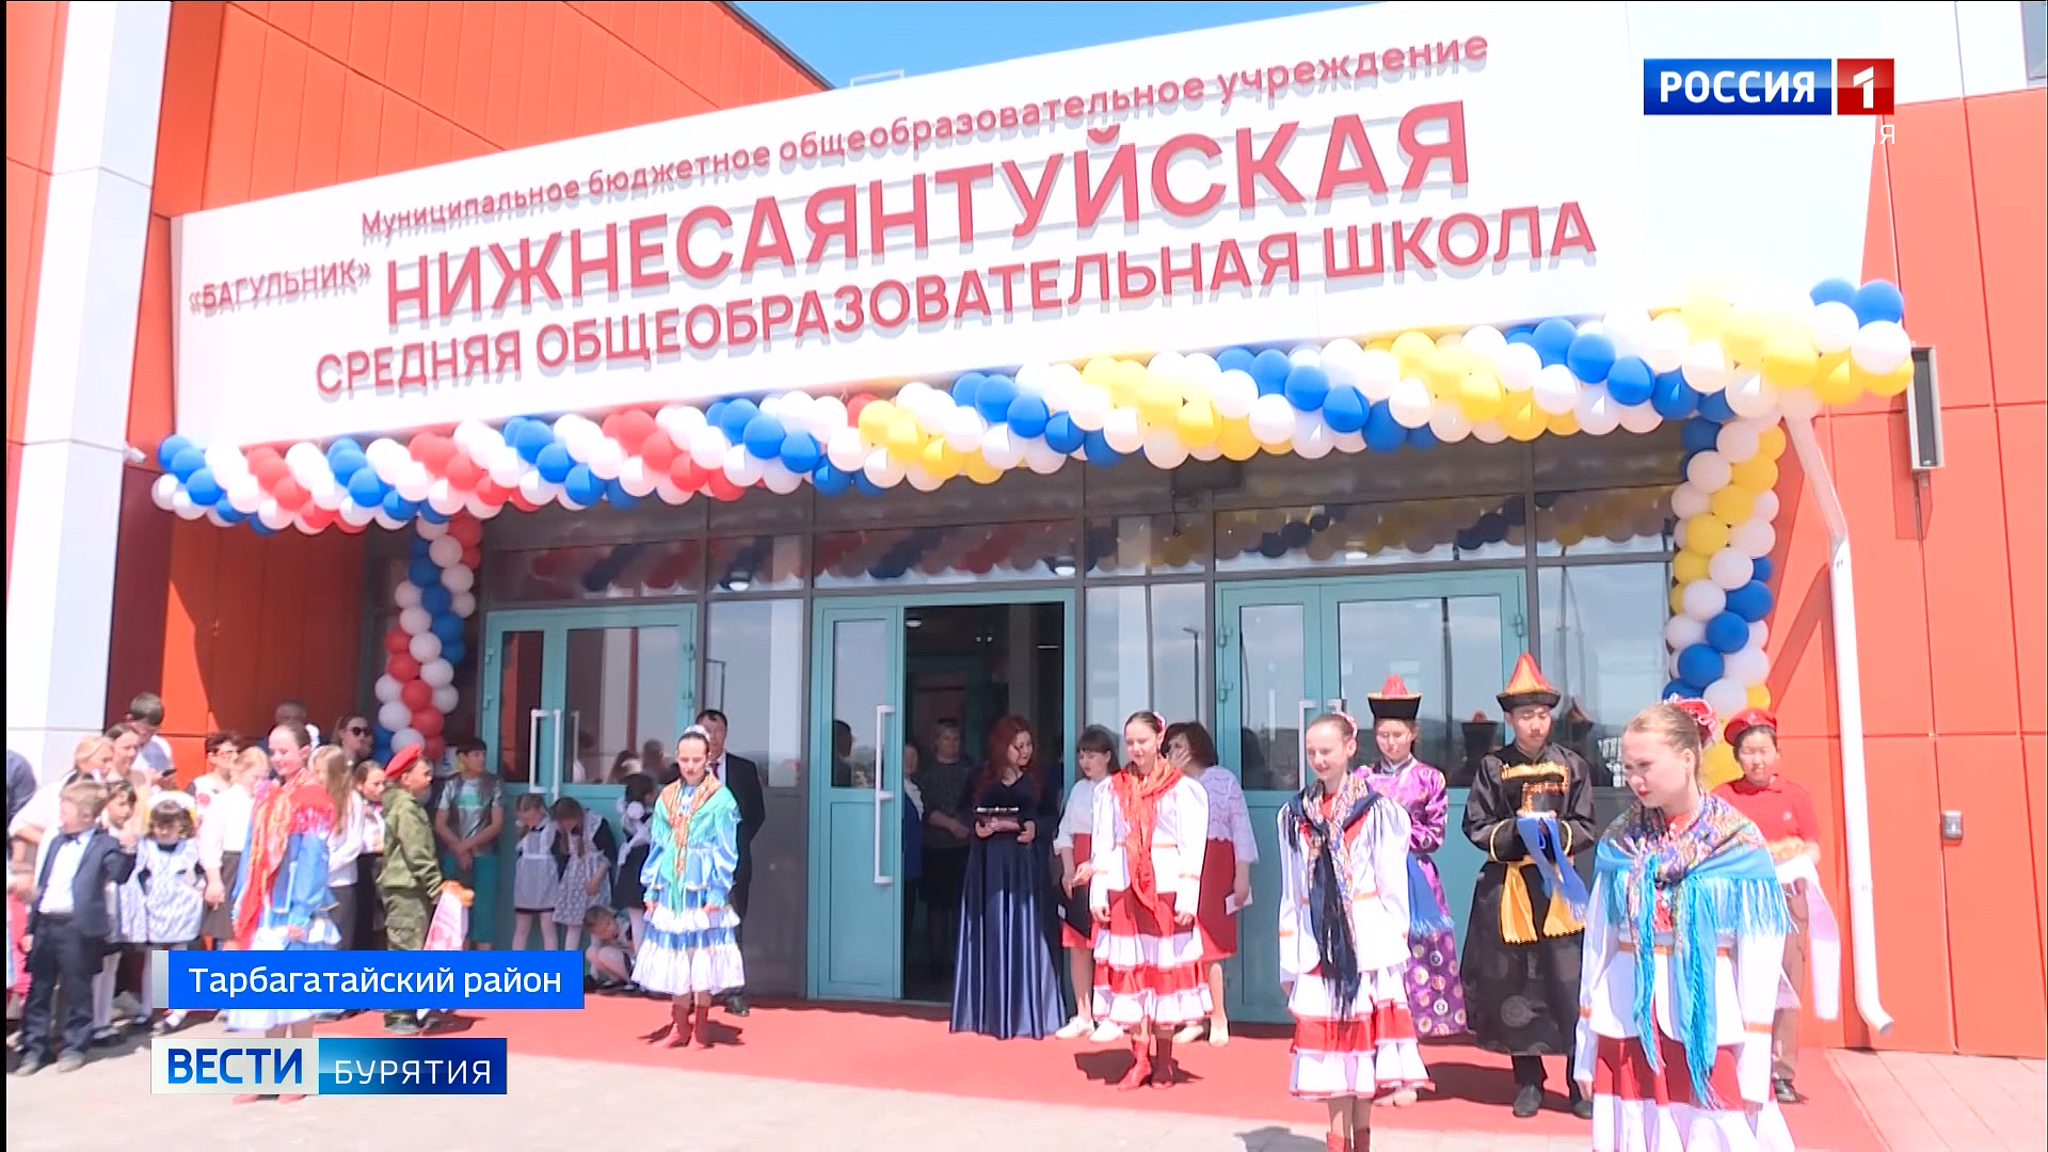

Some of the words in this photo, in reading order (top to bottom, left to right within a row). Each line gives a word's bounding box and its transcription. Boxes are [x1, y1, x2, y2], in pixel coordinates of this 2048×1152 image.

[361, 177, 580, 238] Муниципальное
[588, 143, 771, 193] бюджетное
[780, 76, 1205, 162] общеобразовательное
[1217, 35, 1489, 104] учреждение
[386, 101, 1469, 326] НИЖНЕСАЯНТУЙСКАЯ
[189, 259, 371, 313] «БАГУЛЬНИК»
[316, 329, 522, 395] СРЕДНЯЯ
[536, 232, 1300, 366] ОБЩЕОБРАЗОВАТЕЛЬНАЯ
[1323, 201, 1597, 279] ШКОЛА
